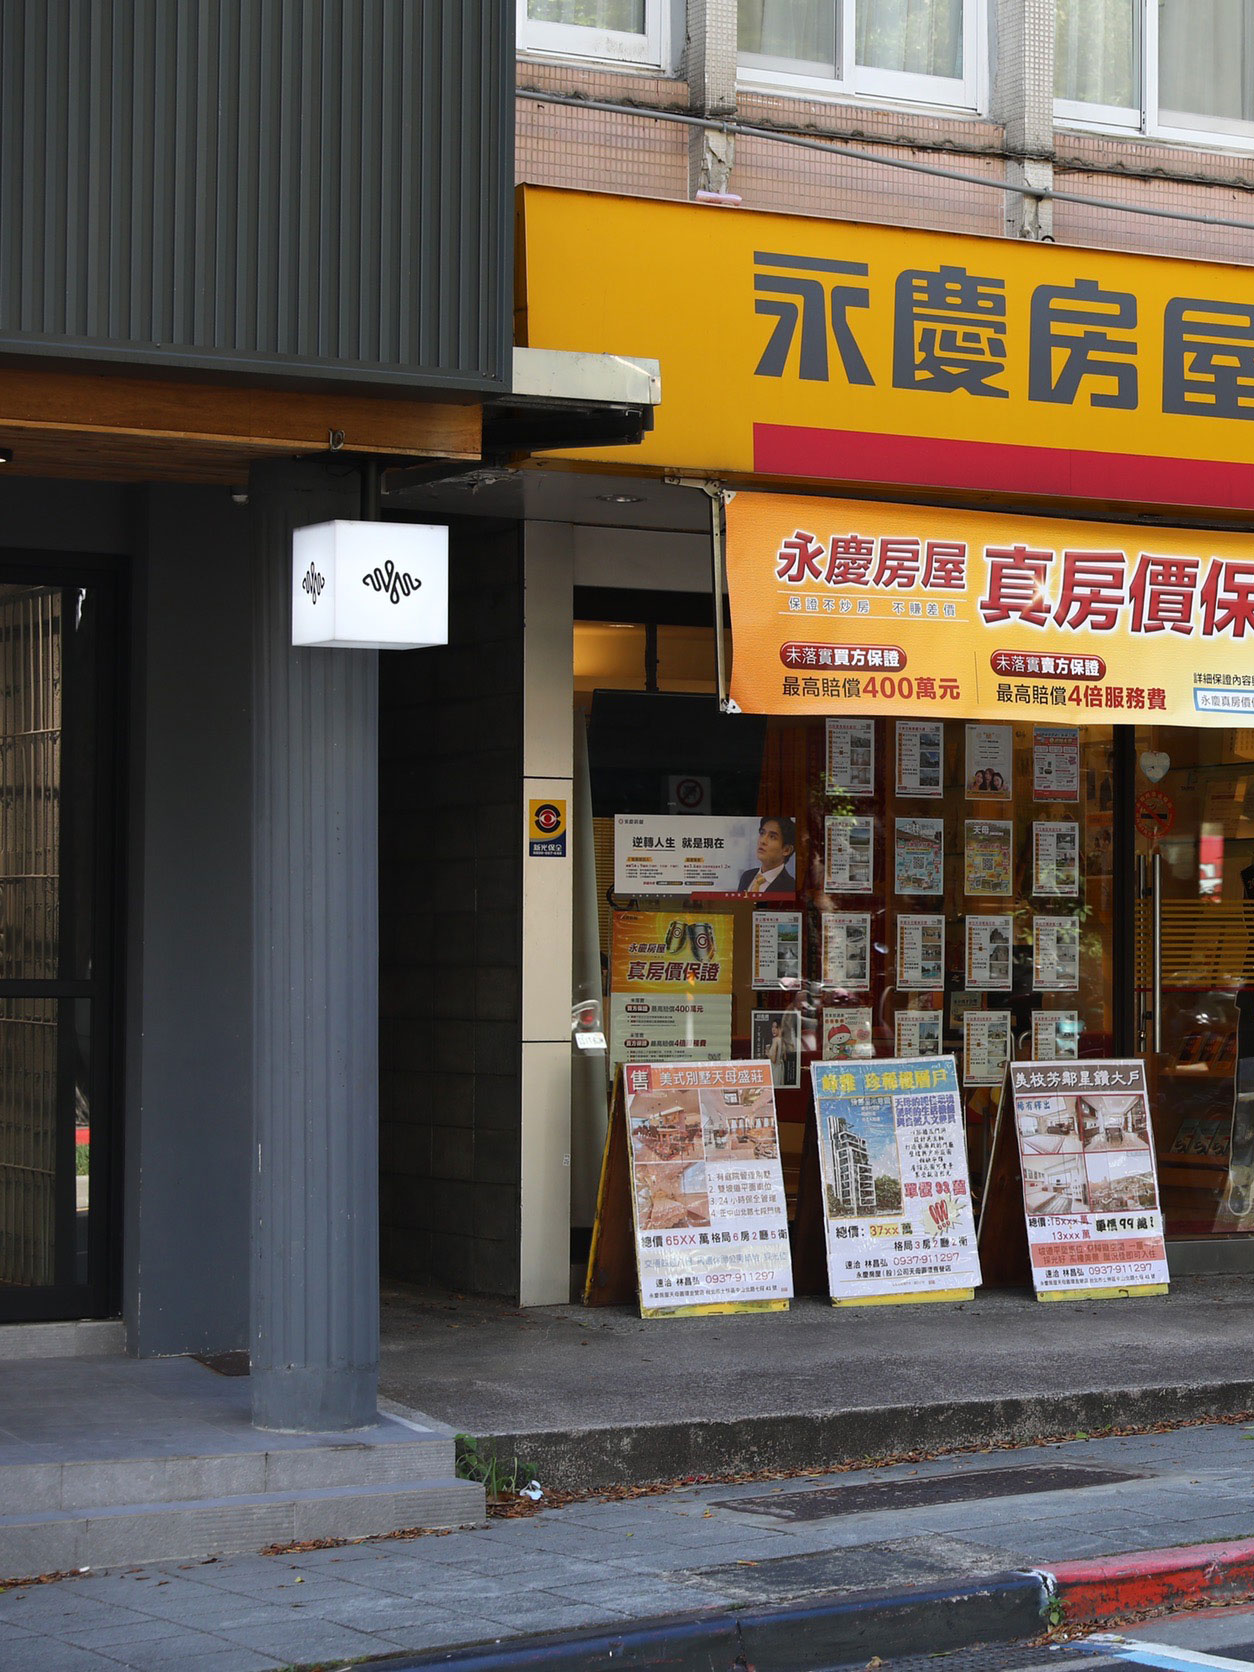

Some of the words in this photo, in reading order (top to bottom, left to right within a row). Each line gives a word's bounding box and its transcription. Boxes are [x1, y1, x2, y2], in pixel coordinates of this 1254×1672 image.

[776, 530, 968, 591] 永慶房屋
[789, 596, 870, 613] 保證不炒房
[892, 600, 956, 617] 不賺差價
[786, 646, 900, 668] 未落實買方保證
[996, 654, 1100, 677] 未落實賣方保證
[782, 675, 960, 701] 最高賠償400萬元
[996, 682, 1167, 711] 最高賠償4倍服務費
[632, 836, 675, 849] 逆轉人生
[682, 837, 725, 849] 就是現在
[627, 961, 720, 982] 真房價保證
[630, 1070, 649, 1091] 售
[659, 1070, 764, 1086] 美式別墅天母盛莊
[1015, 1070, 1139, 1089] 美校芳鄰星鑽大戶
[730, 1194, 777, 1205] 小時保全管理
[901, 1223, 913, 1235] 萬
[1119, 1218, 1134, 1230] 99
[641, 1235, 663, 1249] 總價
[665, 1234, 696, 1246] 65XX
[699, 1232, 710, 1245] 萬
[711, 1230, 731, 1243] 格局
[1082, 1229, 1091, 1239] 萬
[894, 1240, 913, 1251] 格局
[893, 1252, 960, 1266] 0937-911297
[705, 1271, 775, 1284] 0937-911297
[1088, 1263, 1152, 1275] 0937-911297
